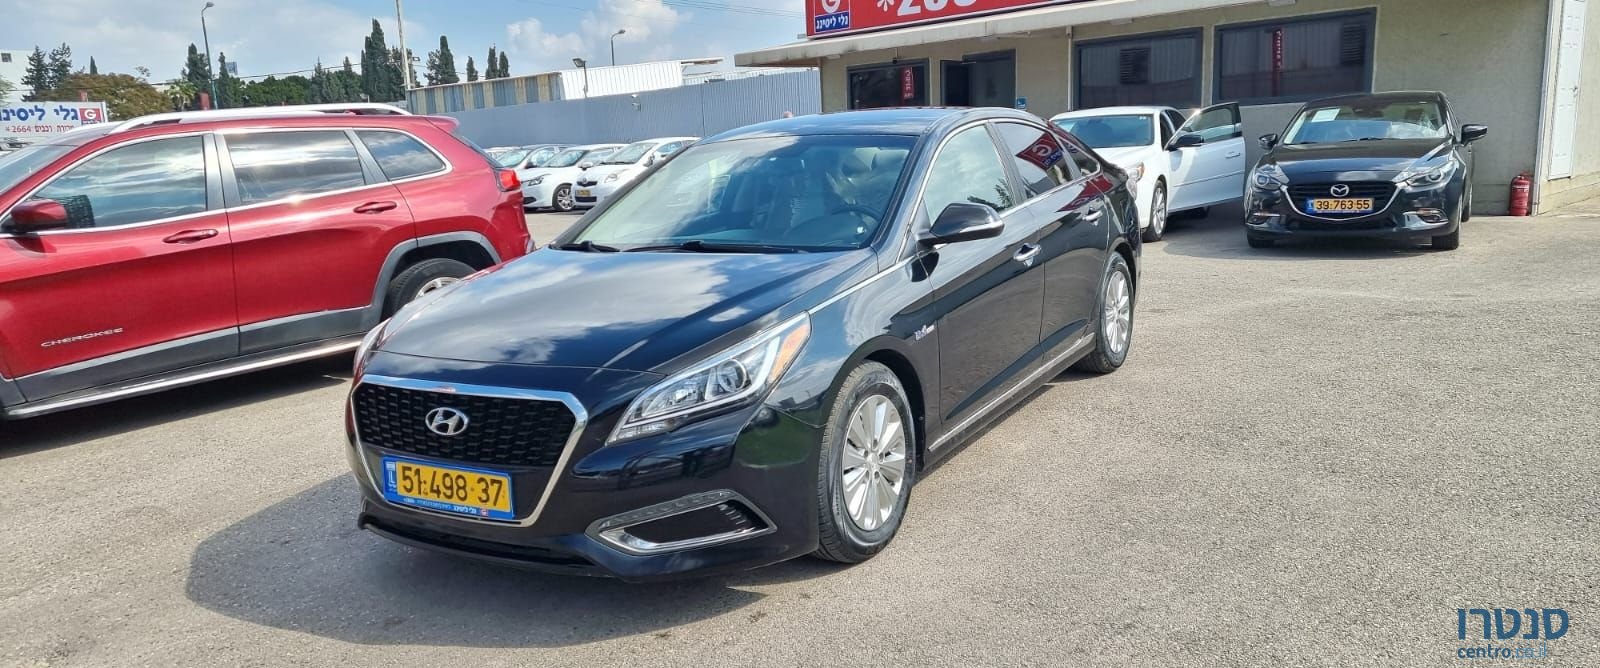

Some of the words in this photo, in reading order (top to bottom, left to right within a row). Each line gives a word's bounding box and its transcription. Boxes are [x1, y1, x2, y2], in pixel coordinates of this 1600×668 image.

[816, 16, 836, 29] ליסינג
[838, 14, 848, 25] גלי
[0, 105, 46, 120] ליסינ
[53, 104, 79, 120] גלי
[41, 328, 123, 347] CHEROKEE
